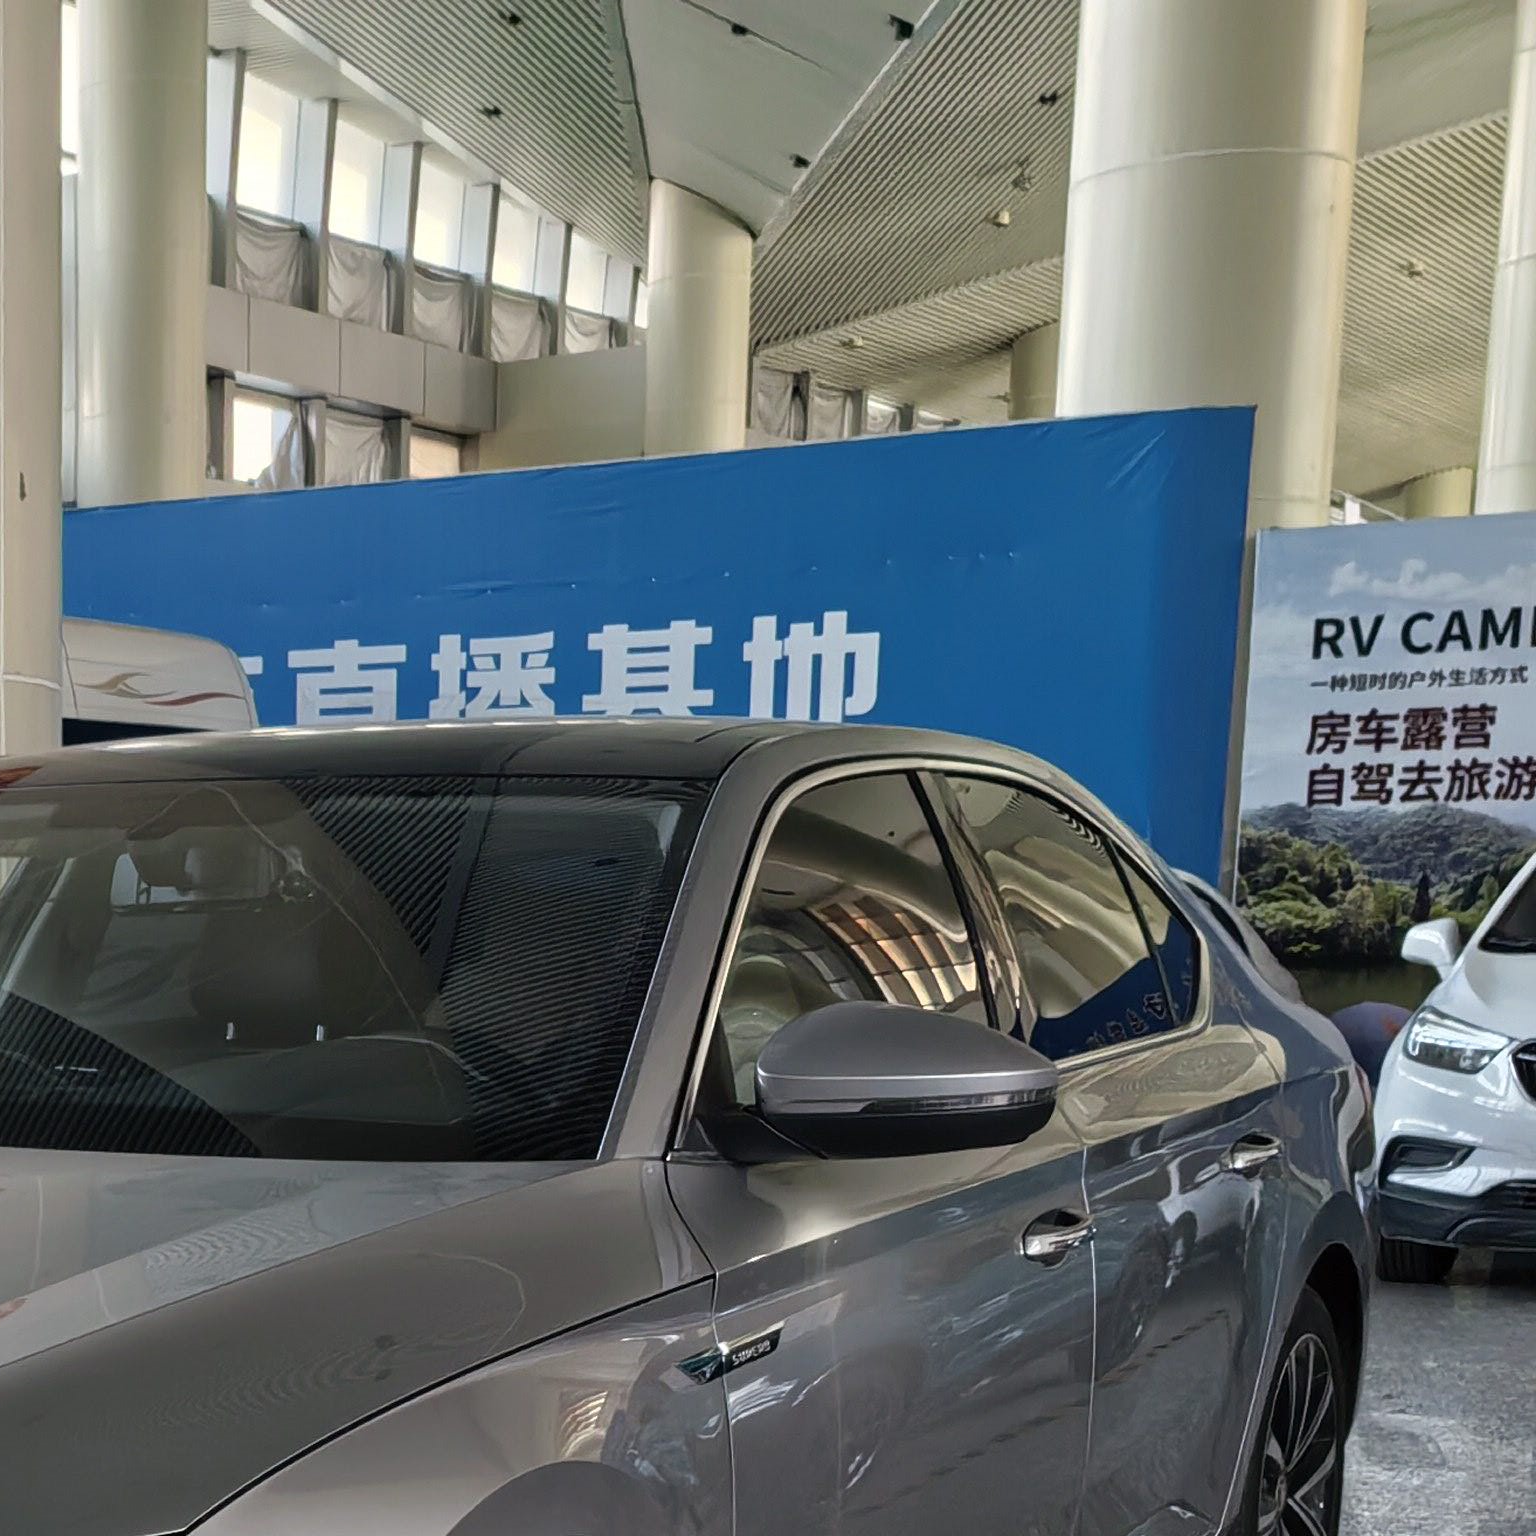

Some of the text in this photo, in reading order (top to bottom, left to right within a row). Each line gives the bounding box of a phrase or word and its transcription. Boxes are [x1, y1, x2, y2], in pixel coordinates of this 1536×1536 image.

[1312, 606, 1536, 660] RV CAM
[243, 609, 882, 724] 直播基地
[1310, 665, 1529, 692] 一种短时的户外生活方式
[1305, 703, 1498, 755] 房车露营
[1306, 756, 1536, 808] 自驾去旅游
